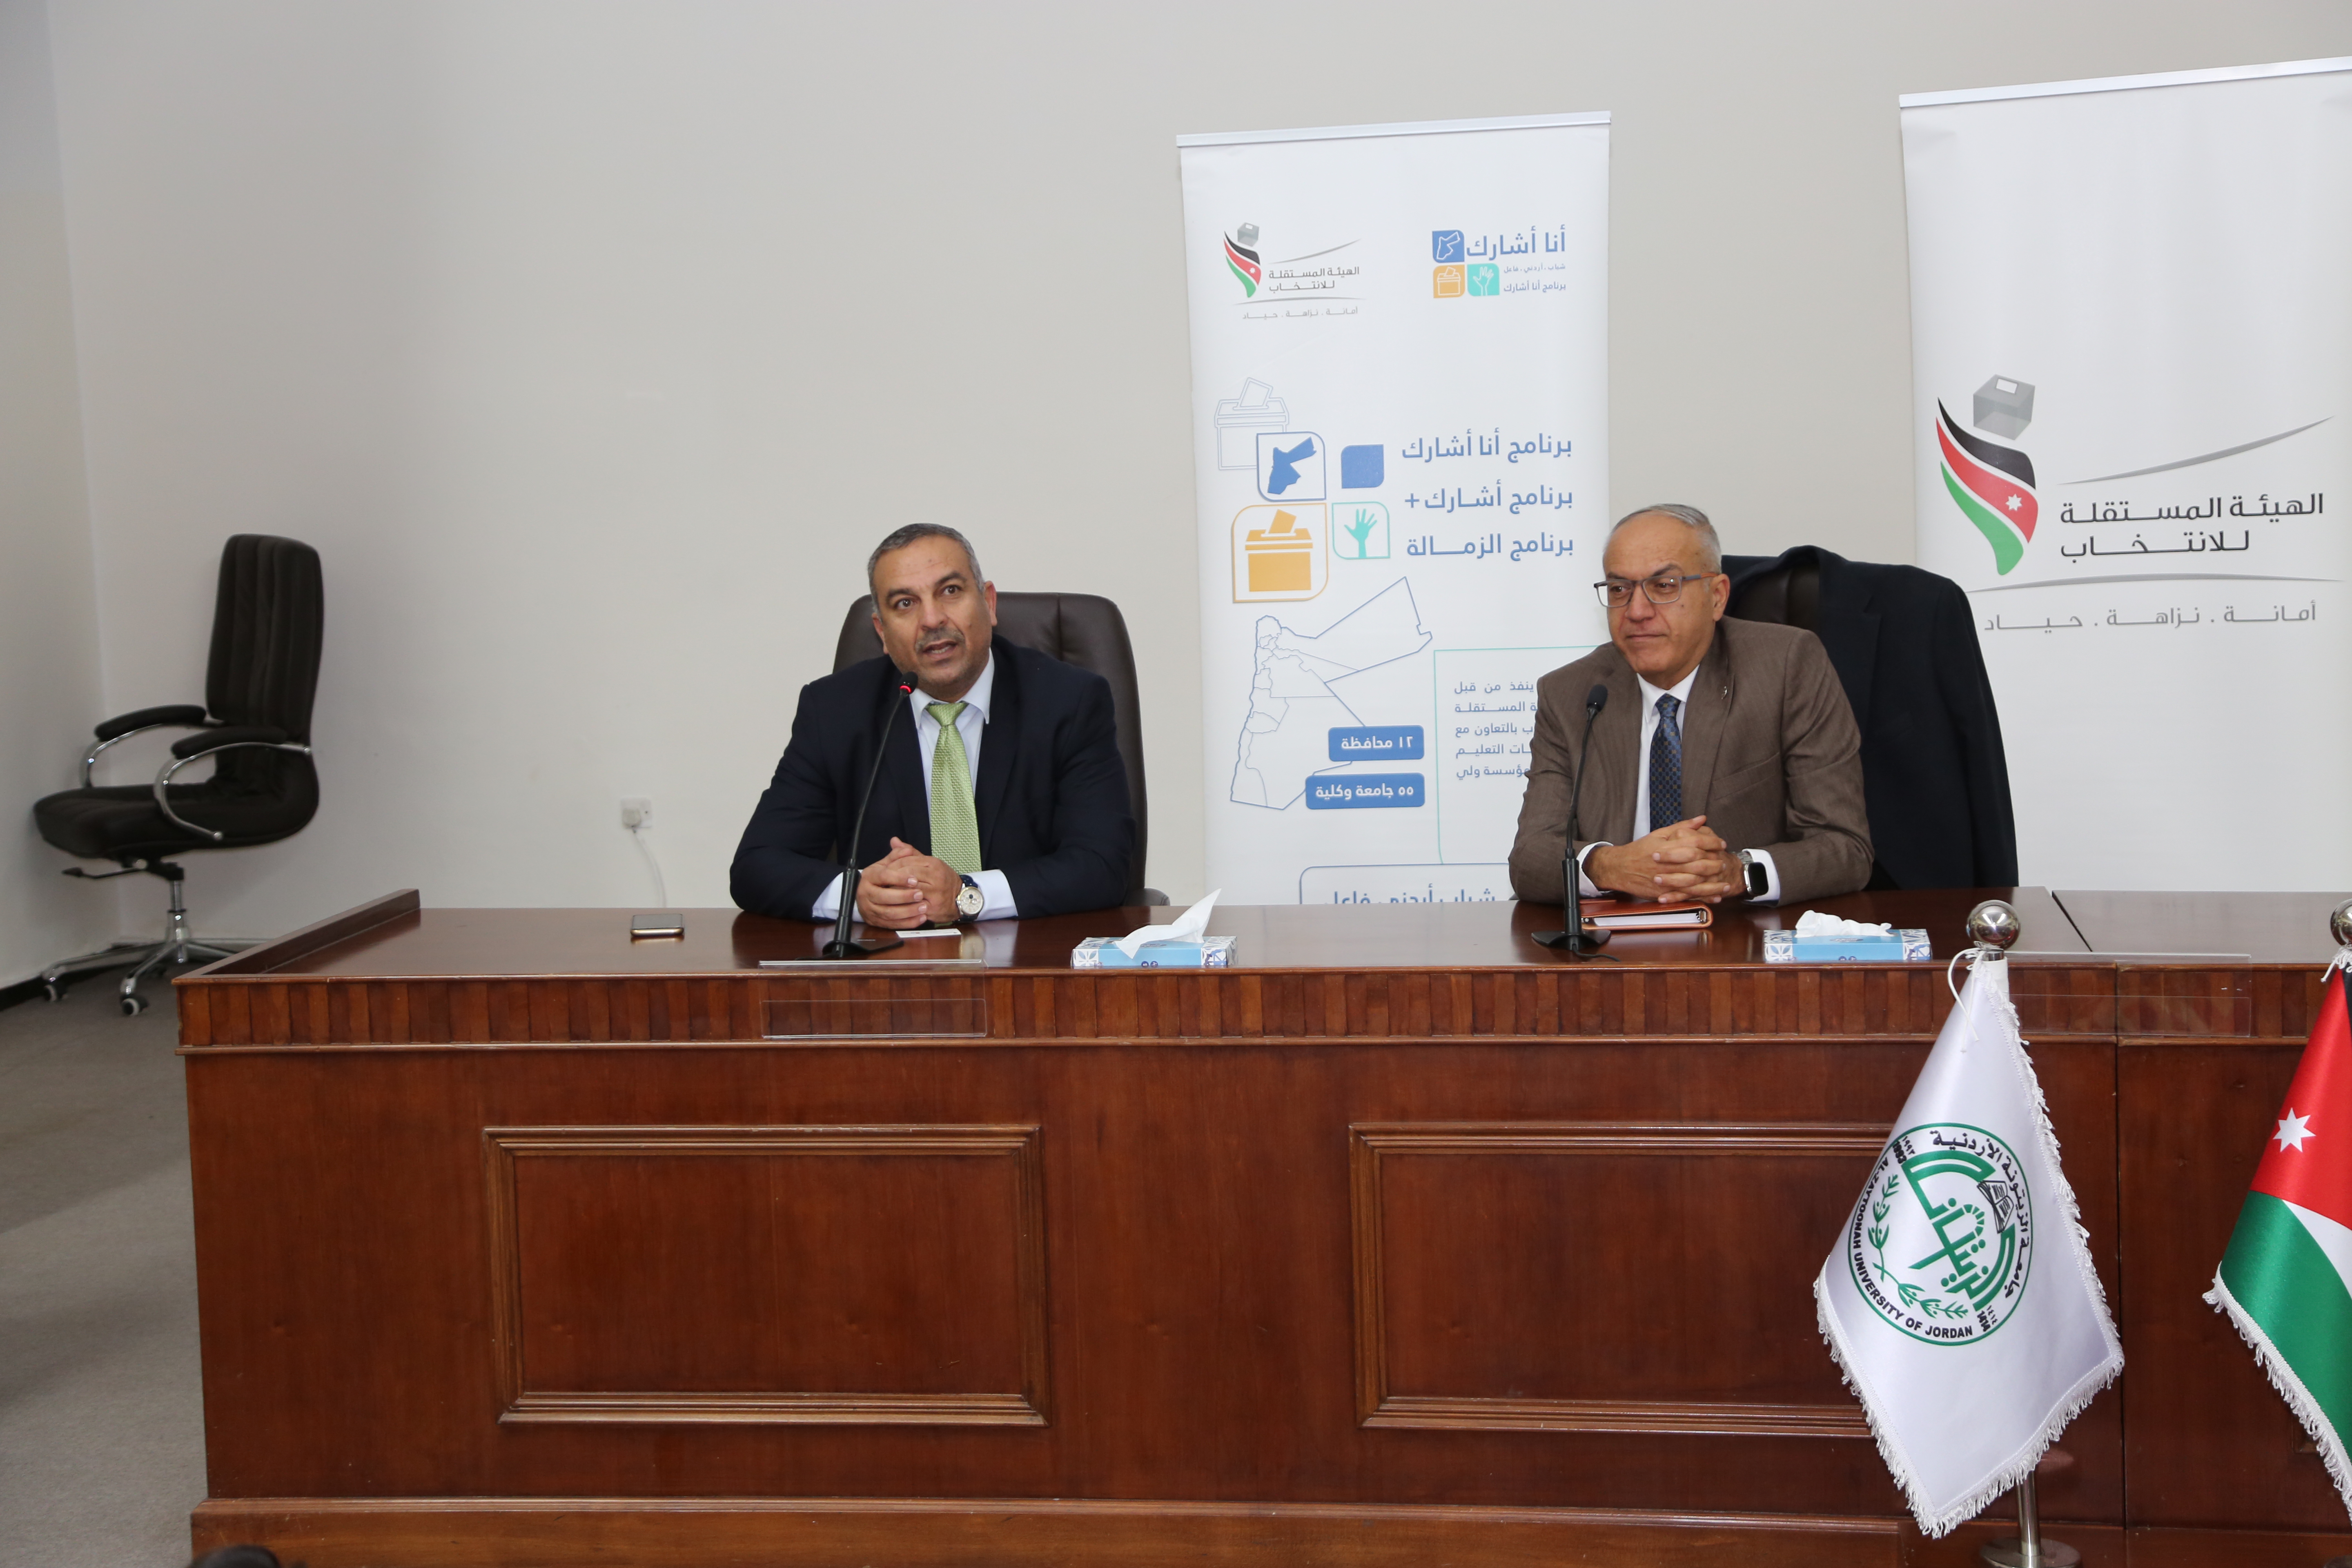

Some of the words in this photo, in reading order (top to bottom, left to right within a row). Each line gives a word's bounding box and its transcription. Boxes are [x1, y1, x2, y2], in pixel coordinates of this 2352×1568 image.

[1466, 225, 1536, 261] أشارك
[1545, 224, 1566, 253] أنا
[1269, 267, 1325, 279] المستقلة
[1327, 266, 1359, 278] الهيئة
[1269, 280, 1335, 294] للانتخاب
[1503, 280, 1530, 293] أشارك
[1532, 279, 1540, 290] أنا
[1542, 281, 1566, 293] برنامج
[1242, 312, 1278, 320] حياد
[1285, 309, 1319, 318] نزاهة
[1325, 305, 1358, 316] أمانة
[1402, 428, 1472, 463] أشارك
[1479, 427, 1499, 456] أنا
[1507, 433, 1572, 463] برنامج
[1509, 484, 1572, 515] برنامج
[2060, 497, 2222, 523] المستقلة
[2230, 492, 2323, 523] الهيئة
[1407, 533, 1501, 559] الزمالة
[1510, 532, 1573, 562] برنامج
[2061, 530, 2249, 564] للانتخاب
[2106, 607, 2200, 629] نزاهة
[2223, 599, 2316, 623] أمانة
[1984, 614, 2083, 634] حياد
[1454, 681, 1476, 695] قبل
[1484, 683, 1501, 694] من
[1510, 681, 1534, 693] ينفذ
[1454, 701, 1526, 713] المستقلة
[1455, 727, 1470, 738] مع
[1474, 722, 1517, 736] بالتعاون
[1341, 735, 1393, 750] محافظة
[1456, 744, 1504, 759] التعليم
[1456, 765, 1480, 780] ولي
[1315, 784, 1352, 801] وكلية
[1355, 783, 1394, 798] جامعة
[1929, 1130, 2003, 1163] الأردنية
[2002, 1155, 2029, 1232] الزيتونة
[1853, 1156, 1889, 1249] AL-ZAYTOONAH
[2004, 1236, 2029, 1298] جامعة
[1854, 1252, 1905, 1321] UNIVERSITY
[1905, 1317, 1923, 1331] OF
[1925, 1325, 1973, 1339] JORDAN
